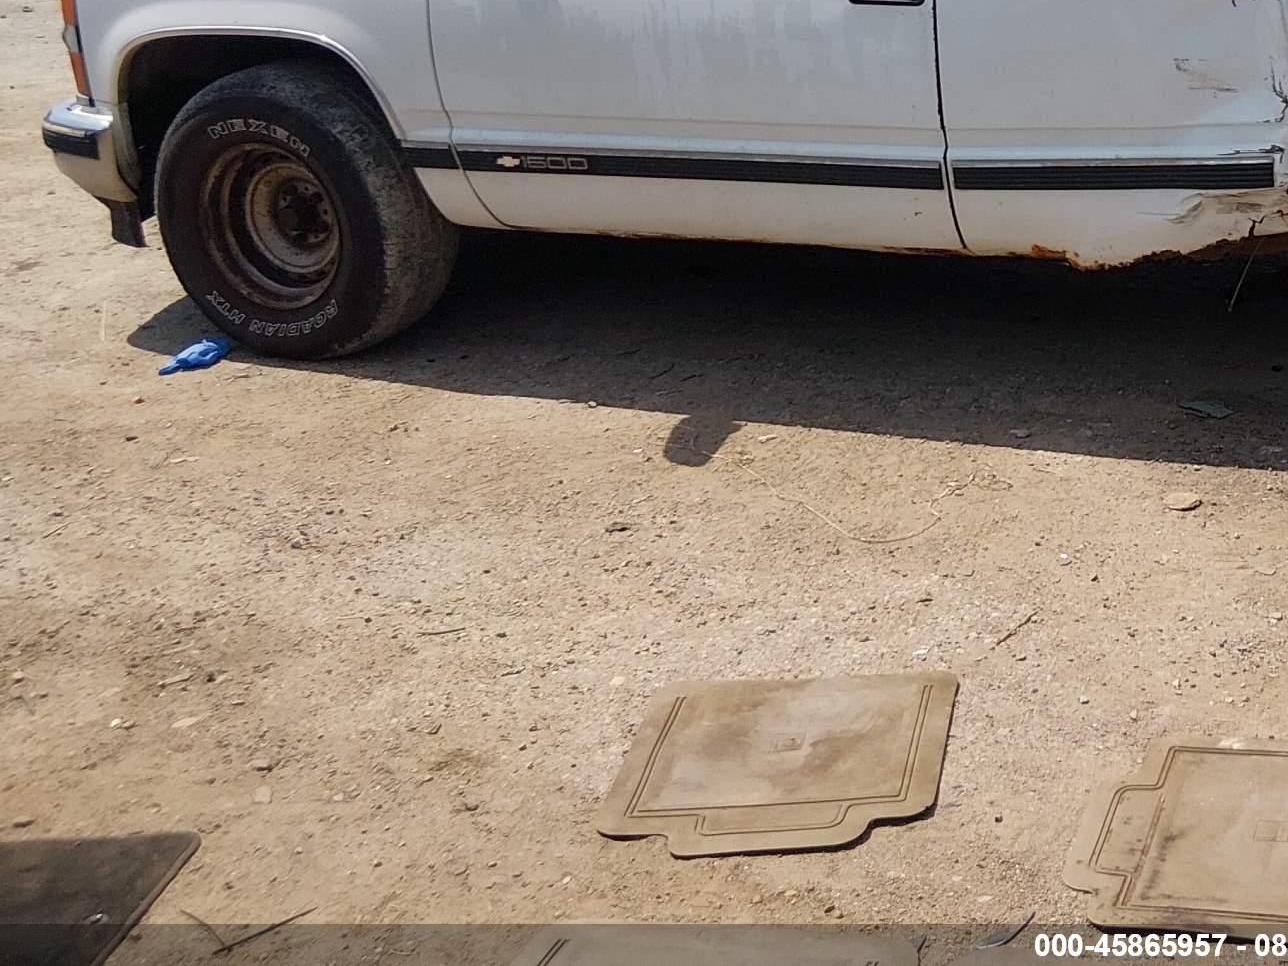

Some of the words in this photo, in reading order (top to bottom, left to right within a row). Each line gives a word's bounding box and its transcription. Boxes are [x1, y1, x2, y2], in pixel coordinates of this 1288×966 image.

[521, 155, 589, 170] 1500
[204, 290, 247, 325] HTX
[248, 298, 338, 337] ROADIAN
